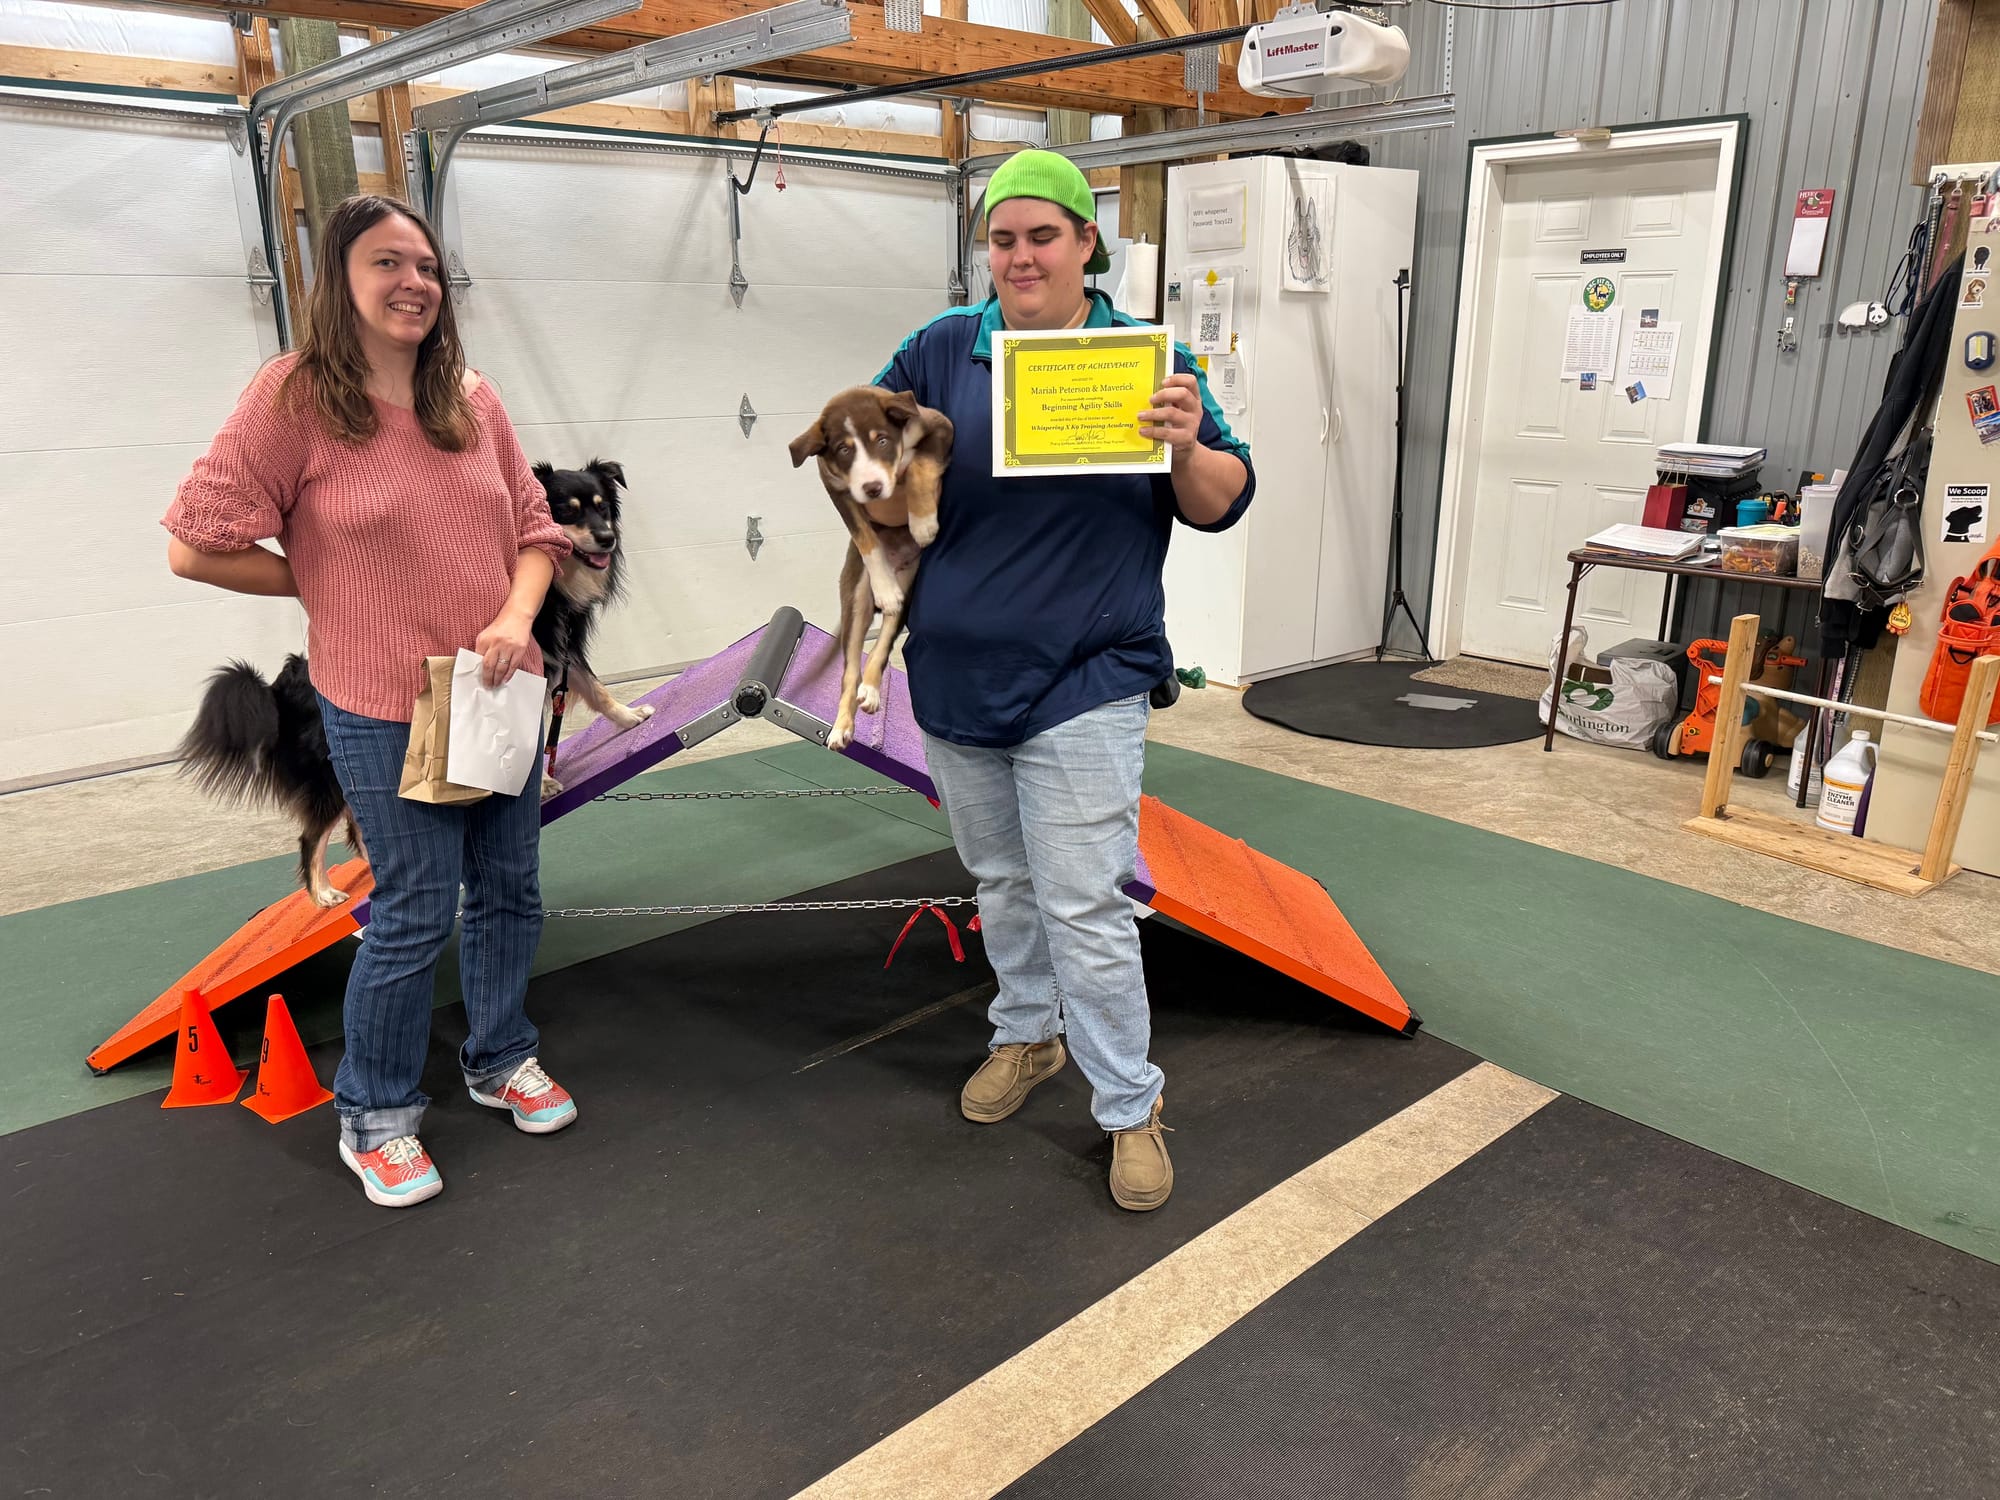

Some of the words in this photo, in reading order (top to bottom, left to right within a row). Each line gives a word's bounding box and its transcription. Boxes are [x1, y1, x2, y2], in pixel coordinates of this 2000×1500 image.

[1267, 42, 1319, 57] LiftMaster
[1028, 363, 1075, 372] CERTIFICATE
[1076, 363, 1087, 371] OF
[1088, 361, 1139, 370] ACHIEVEMENT
[1031, 387, 1057, 395] Mariah
[1059, 385, 1090, 394] Peterson
[1100, 383, 1134, 392] Maverick
[1042, 403, 1078, 412] Beginning
[1080, 402, 1101, 410] Agility
[1031, 424, 1064, 432] Whispering
[1107, 422, 1134, 430] Academy
[1827, 791, 1853, 801] ENZYME
[1827, 796, 1855, 806] CLEANER
[188, 1025, 199, 1053] 5
[261, 1037, 270, 1064] 9
